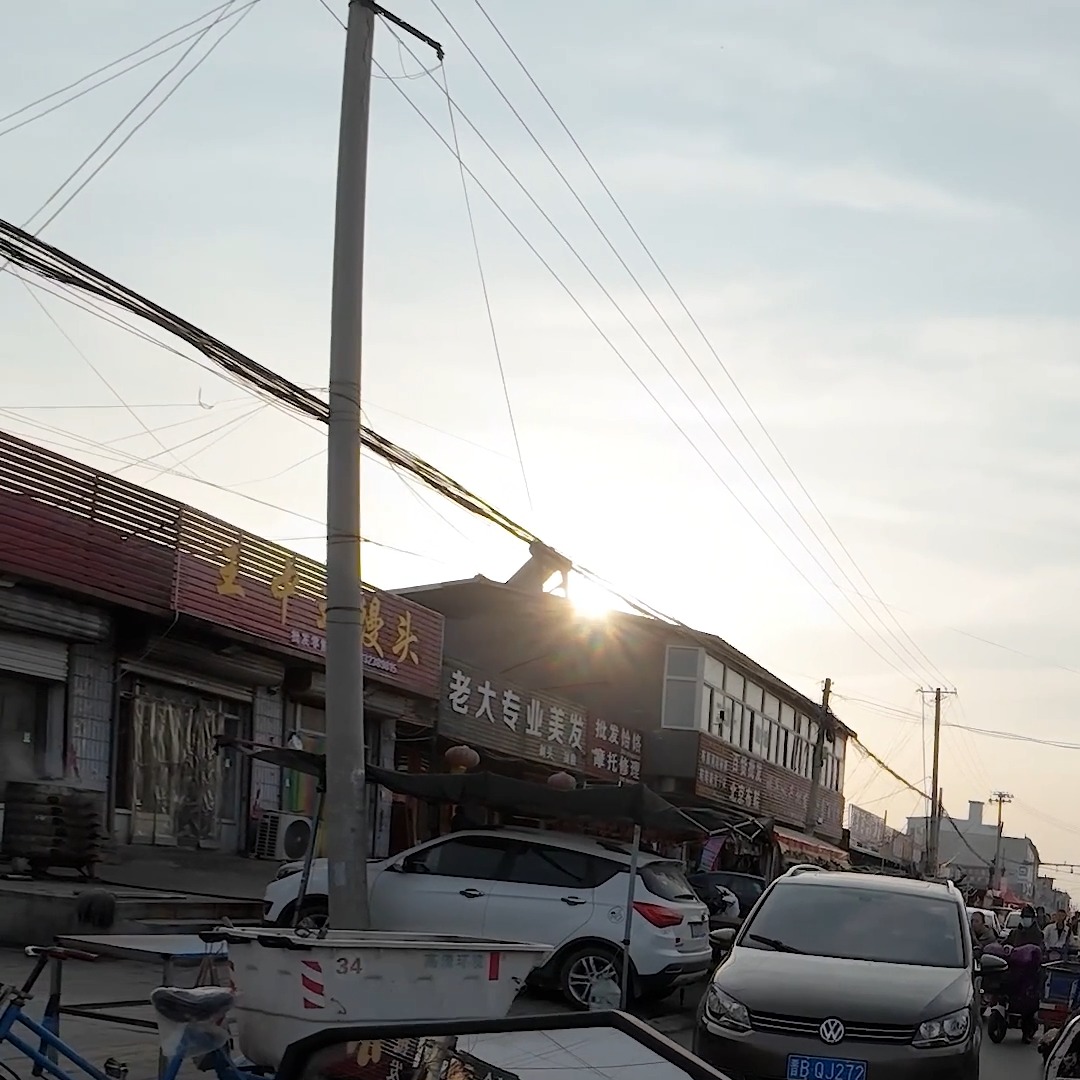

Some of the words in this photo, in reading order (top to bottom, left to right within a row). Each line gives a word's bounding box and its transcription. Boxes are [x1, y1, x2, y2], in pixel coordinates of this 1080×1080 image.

[448, 669, 585, 753] 老大专业美发
[591, 747, 640, 780] 摩托修理
[336, 957, 362, 974] 34
